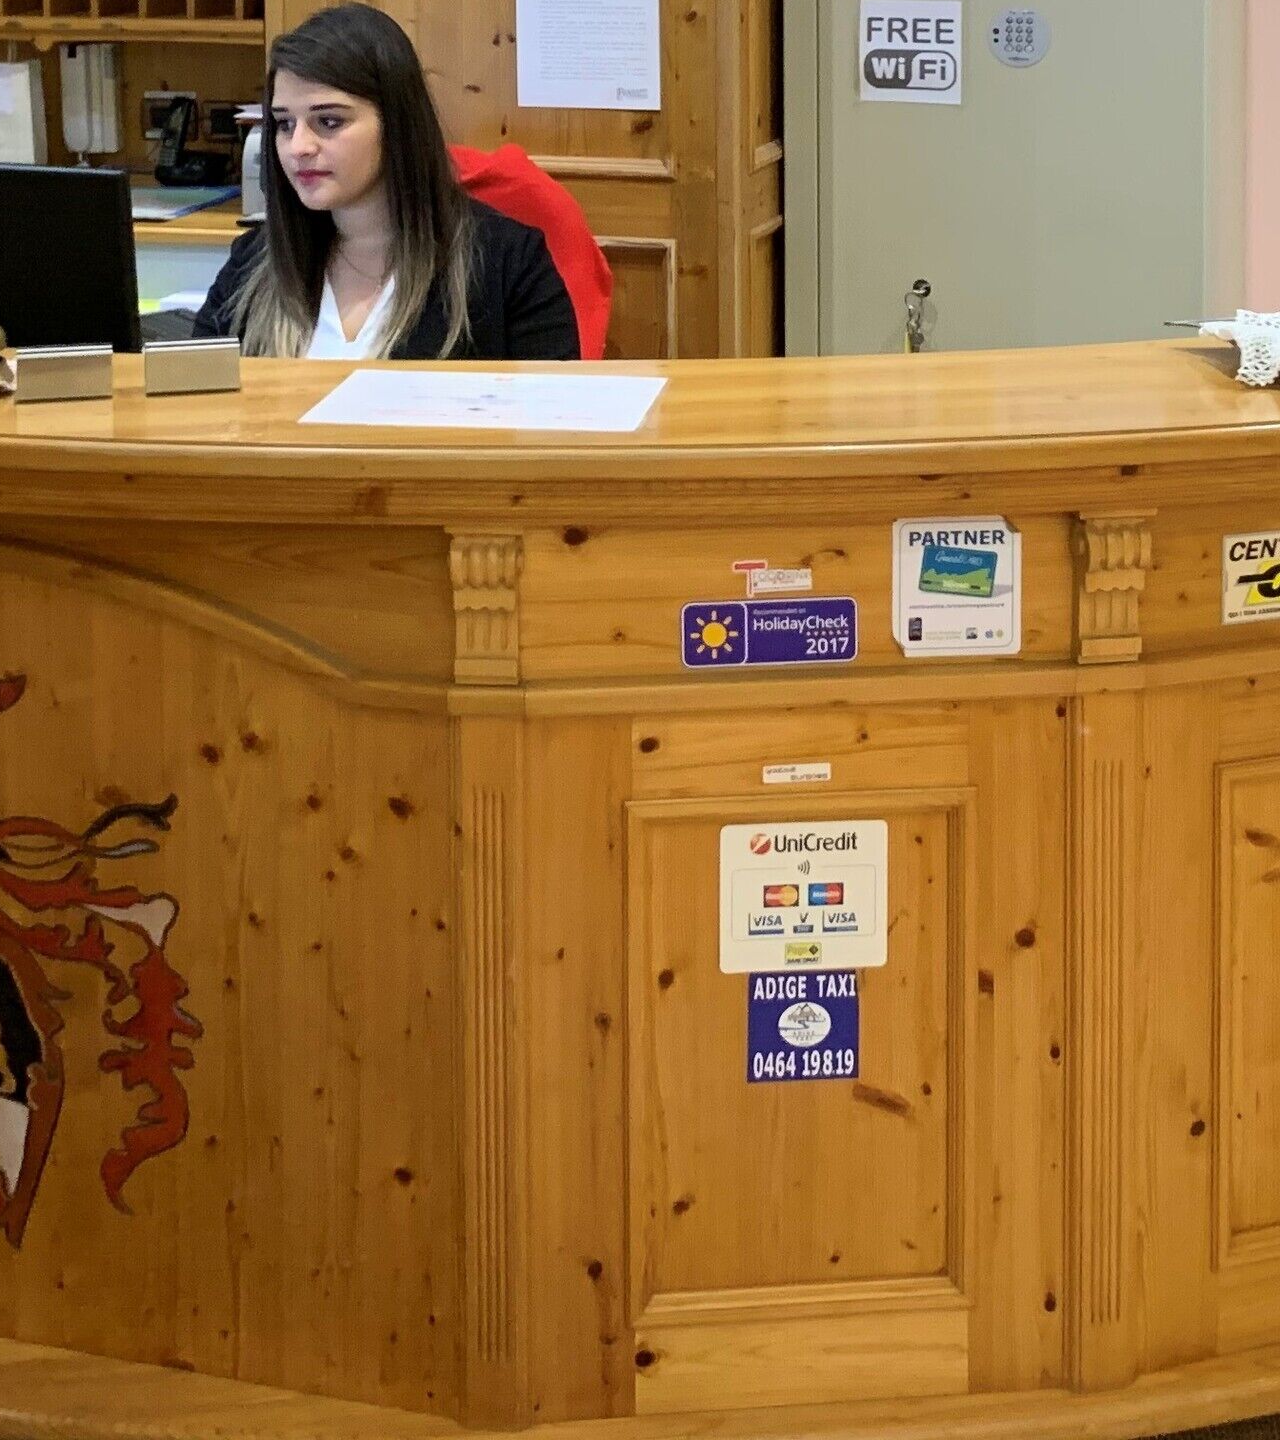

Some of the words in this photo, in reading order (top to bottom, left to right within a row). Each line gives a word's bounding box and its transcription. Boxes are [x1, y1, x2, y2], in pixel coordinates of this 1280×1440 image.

[867, 17, 955, 44] FREE
[909, 529, 1005, 547] PARTNER
[753, 615, 849, 634] HolidayCheck
[805, 637, 849, 655] 2017
[774, 832, 858, 853] UniCredit
[754, 915, 783, 926] VISA
[827, 912, 856, 923] VISA
[753, 975, 807, 1000] ADIGE
[816, 974, 856, 998] TAXI
[753, 1050, 796, 1079] 0464
